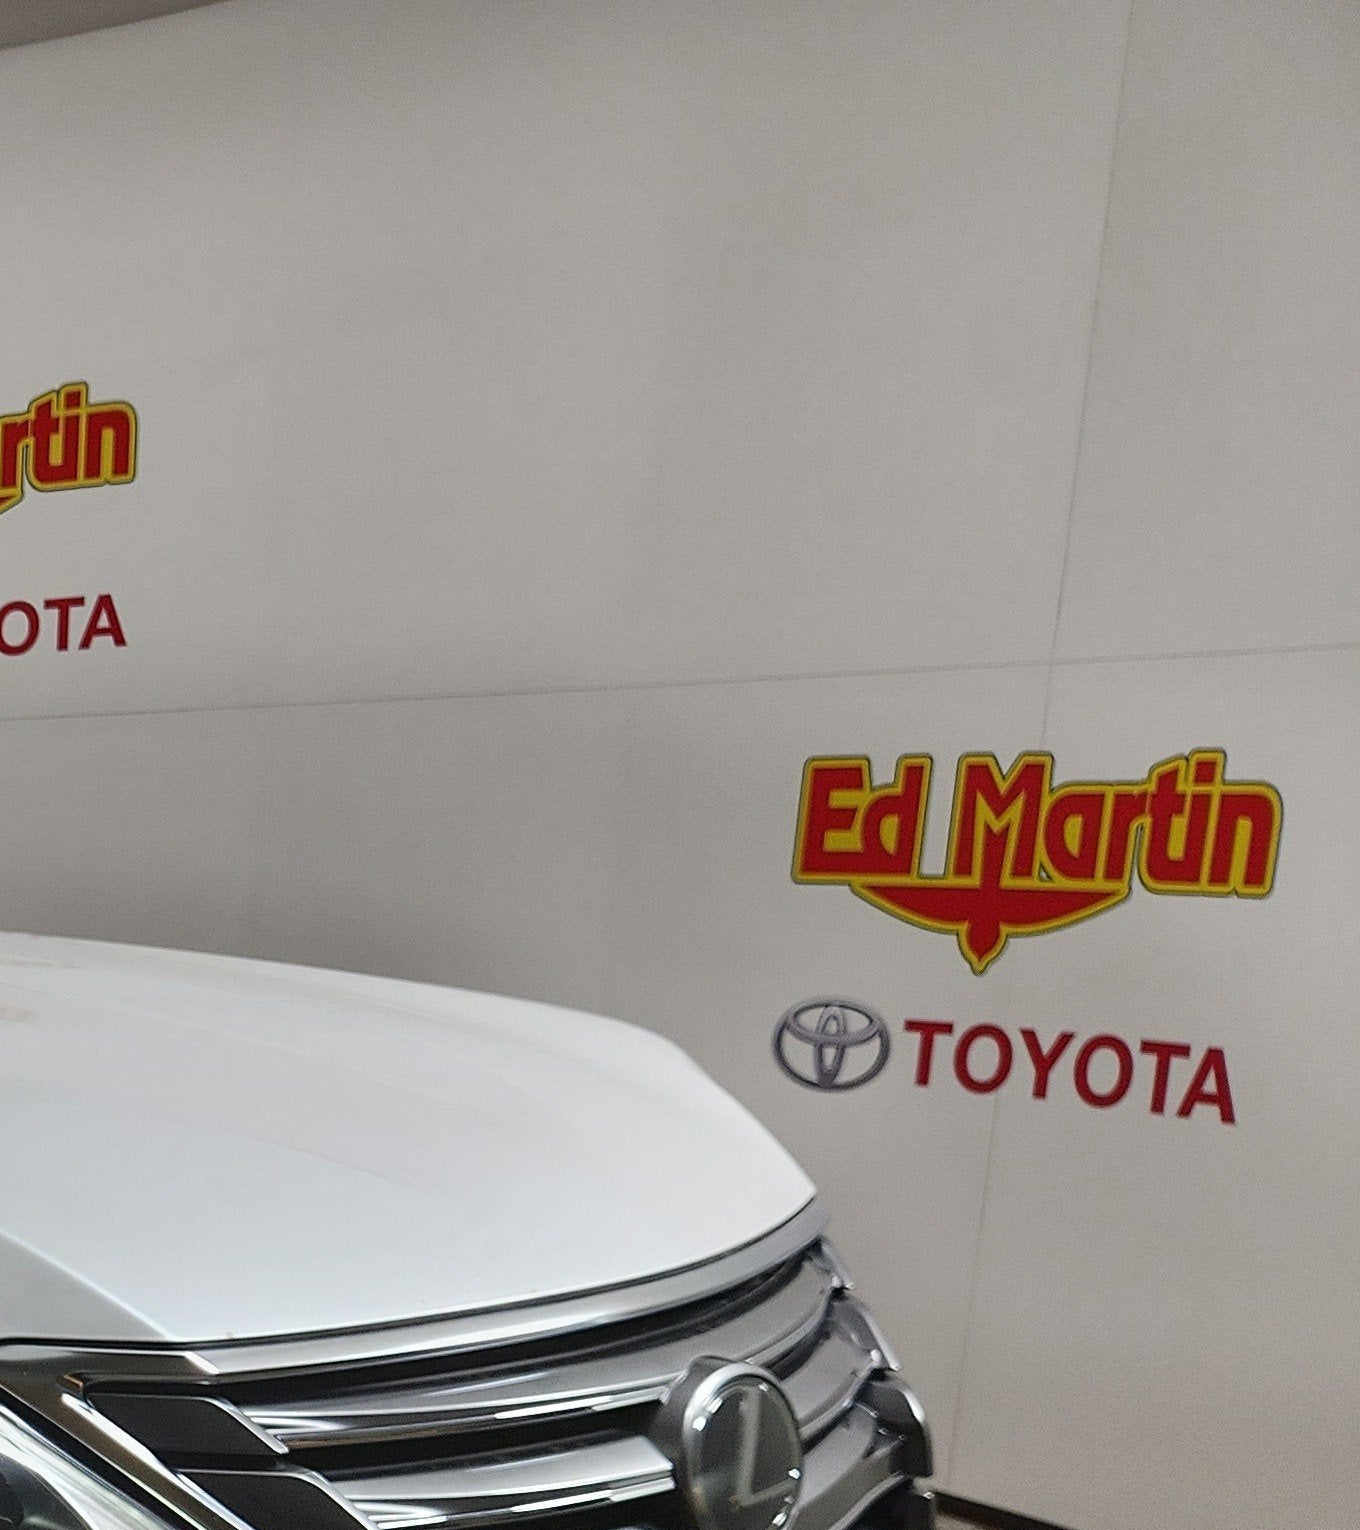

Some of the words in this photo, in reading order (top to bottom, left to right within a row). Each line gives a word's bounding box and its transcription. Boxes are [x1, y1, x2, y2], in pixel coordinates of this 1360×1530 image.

[798, 761, 927, 878] Ed
[952, 758, 1279, 888] Martin
[902, 1017, 1237, 1126] TOYOTA
